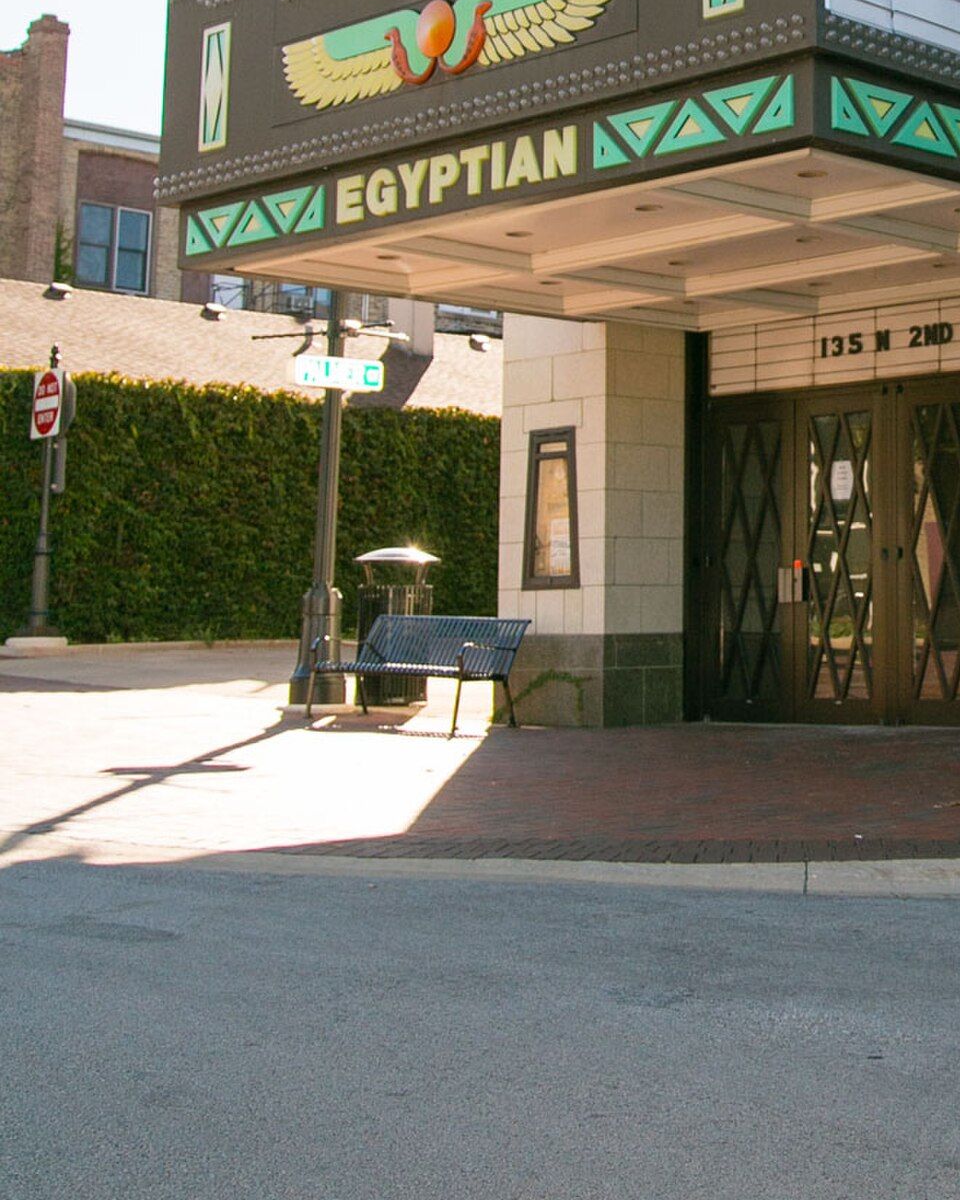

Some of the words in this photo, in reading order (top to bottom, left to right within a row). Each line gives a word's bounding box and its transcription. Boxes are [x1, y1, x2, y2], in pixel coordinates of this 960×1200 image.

[336, 125, 578, 225] EGYPTIAN
[821, 332, 864, 358] 135
[875, 329, 890, 352] N
[909, 322, 954, 348] 2ND
